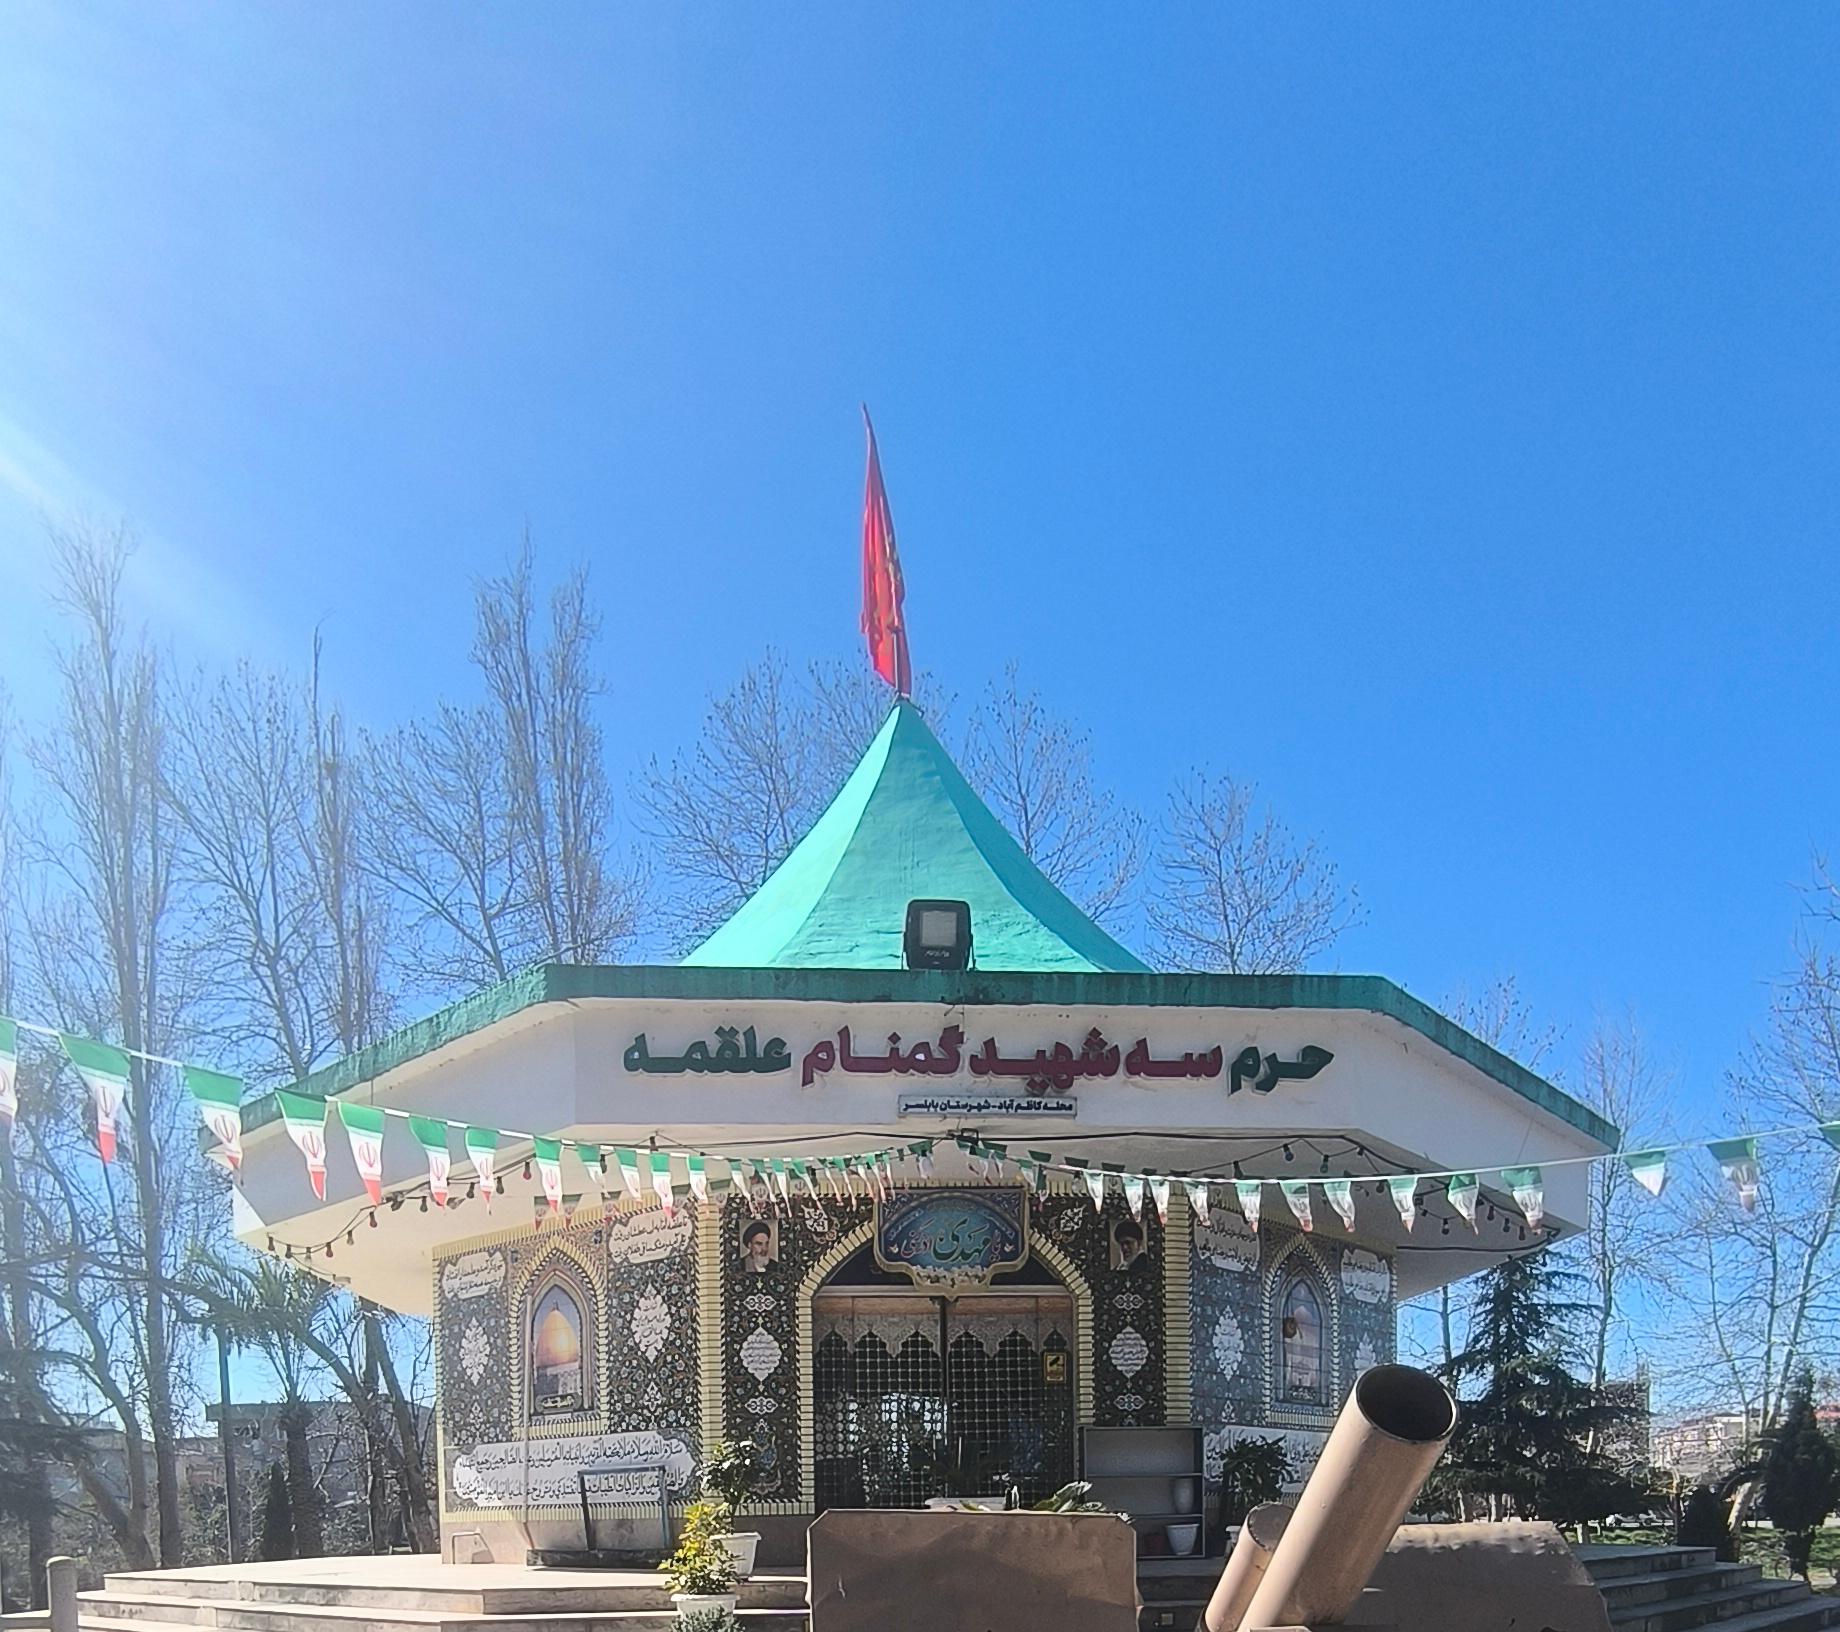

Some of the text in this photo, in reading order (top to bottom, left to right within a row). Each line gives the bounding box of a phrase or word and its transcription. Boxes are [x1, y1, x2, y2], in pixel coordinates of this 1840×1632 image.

[623, 1024, 1334, 1095] حرم سه شهید گمنام علقمه
[903, 1100, 939, 1113] بابلسر
[1014, 1100, 1043, 1113] کاظم
[1044, 1101, 1073, 1112] محله
[931, 1216, 992, 1263] مهدی
[989, 1229, 1001, 1262] یا
